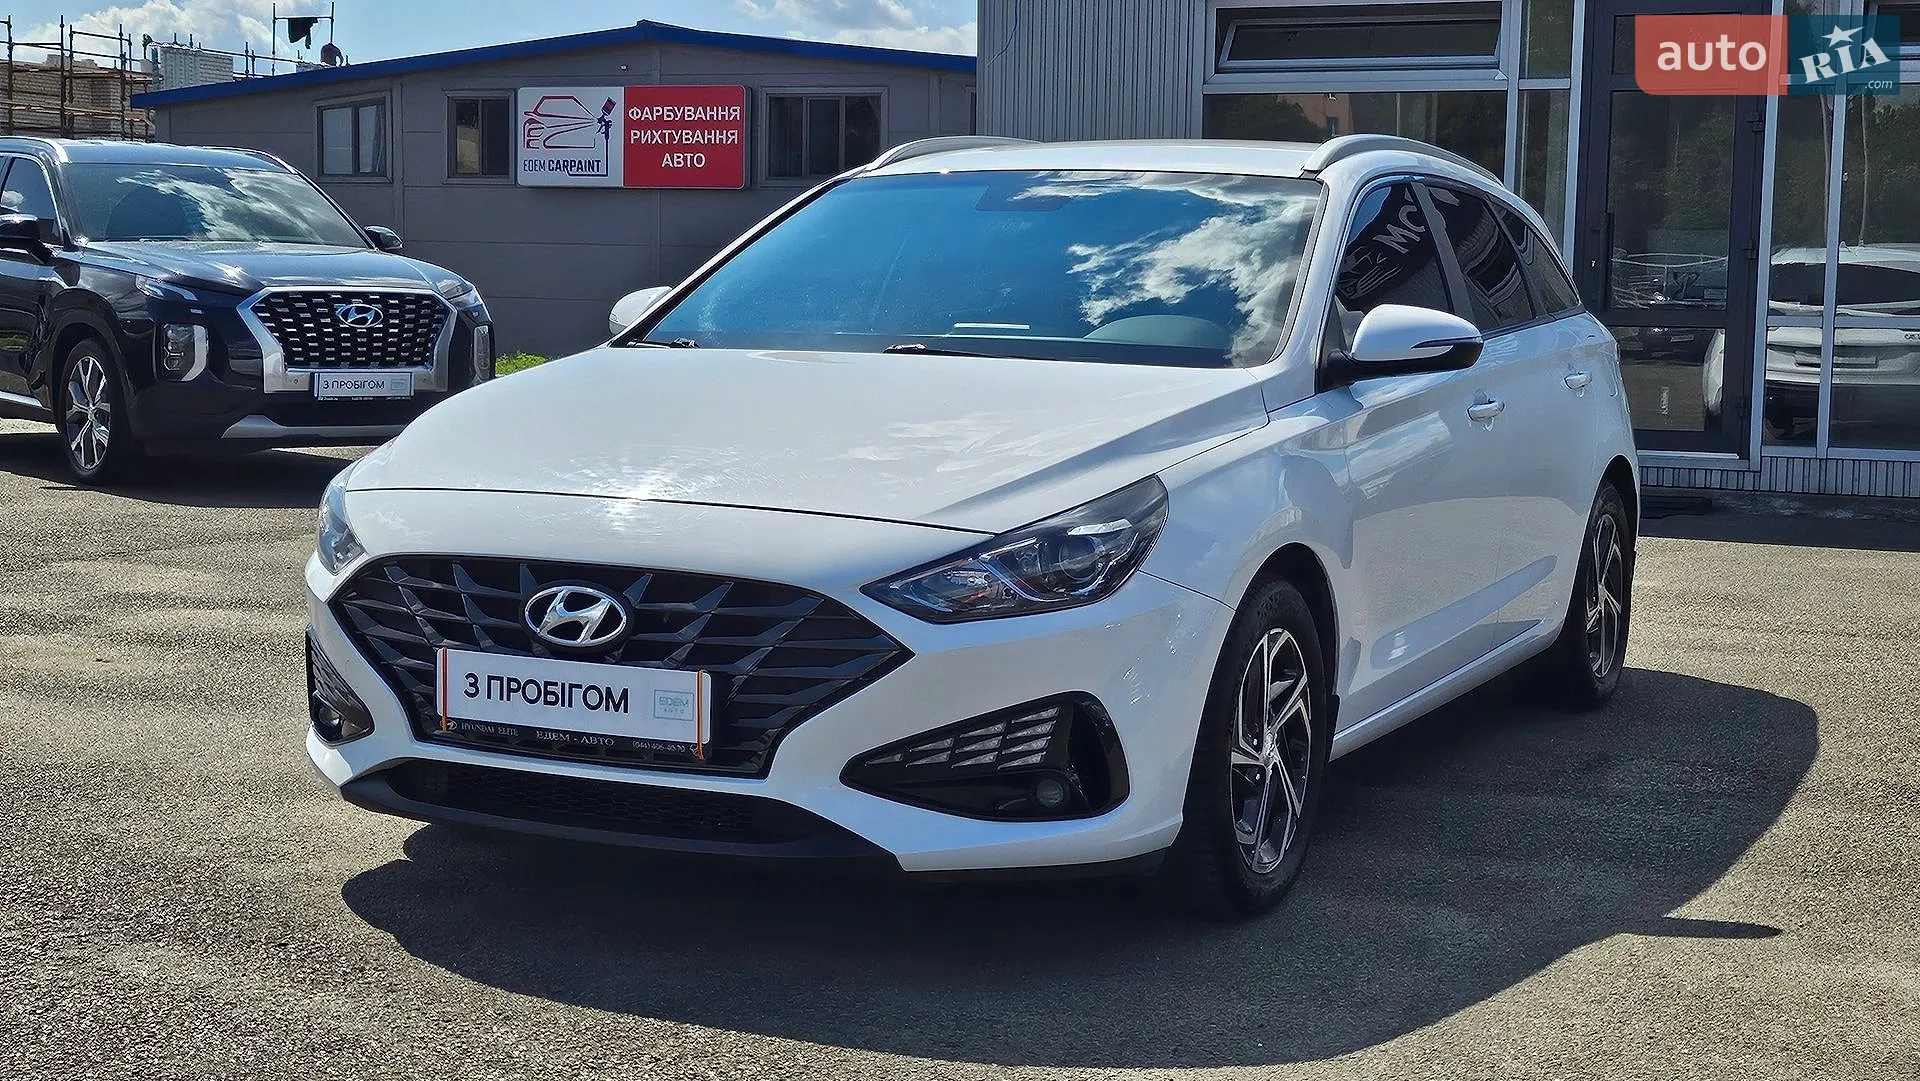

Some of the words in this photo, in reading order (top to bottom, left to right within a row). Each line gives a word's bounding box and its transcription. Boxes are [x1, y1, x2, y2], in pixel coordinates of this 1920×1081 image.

[628, 106, 741, 121] ФАРБУВАННЯ
[630, 130, 738, 144] РИХТУВАННЯ
[548, 159, 602, 173] CARPAINT
[662, 153, 706, 168] АВТО
[331, 380, 385, 390] ПРОБІГОМ
[486, 674, 629, 714] ПРОБІГОМ
